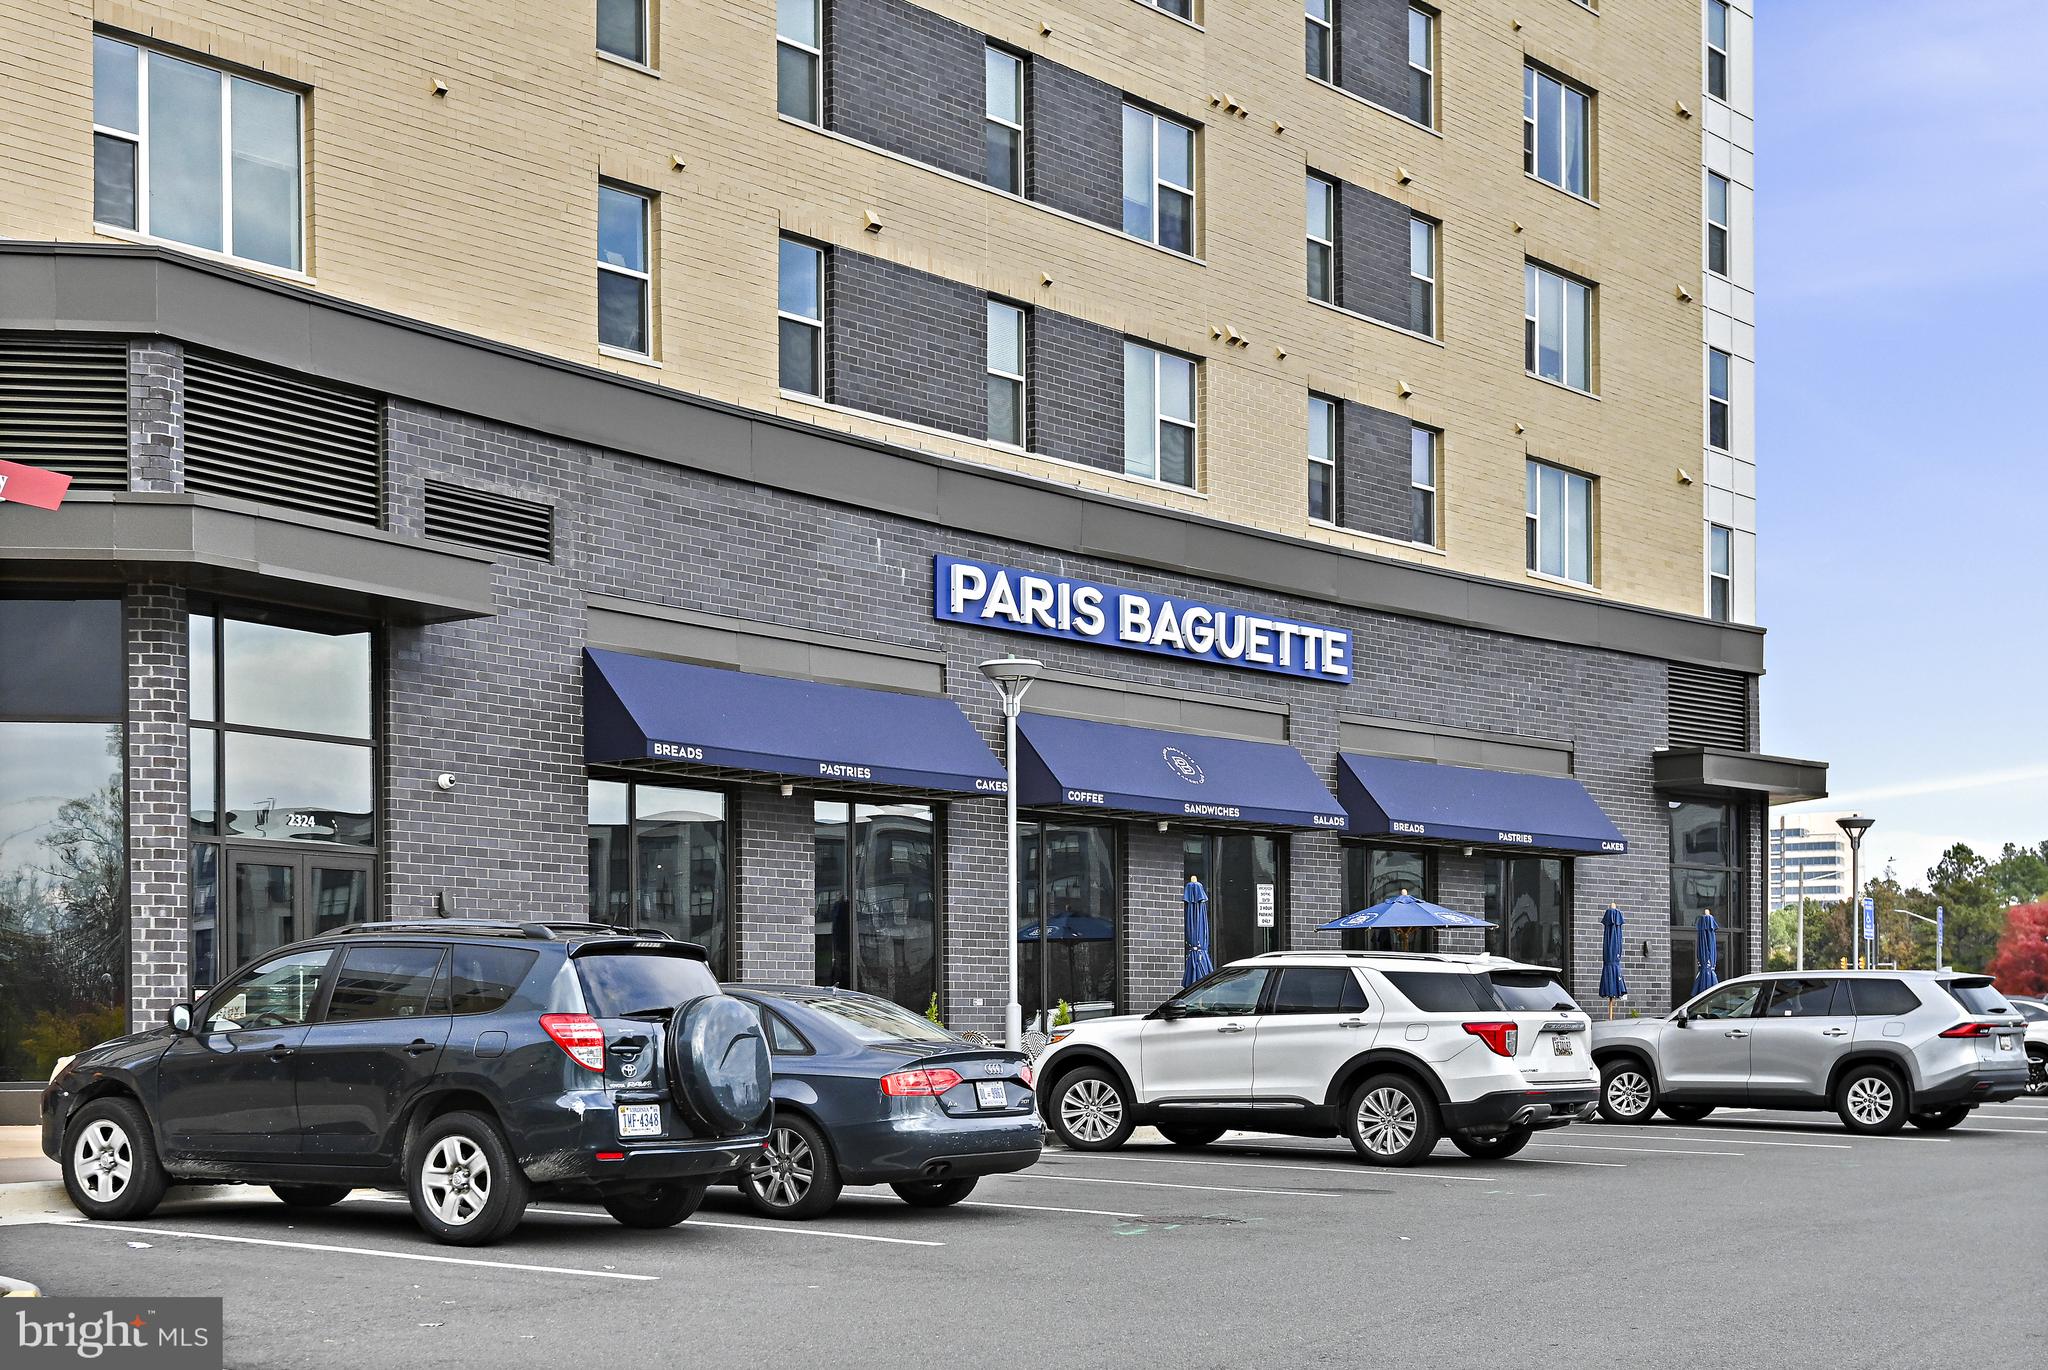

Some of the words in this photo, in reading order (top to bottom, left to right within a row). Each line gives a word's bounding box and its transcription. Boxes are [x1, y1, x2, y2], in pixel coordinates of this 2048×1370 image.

[950, 563, 1106, 636] PARIS
[1119, 593, 1348, 675] BAGUETTE
[653, 743, 704, 760] BREADS
[819, 763, 871, 779] PASTRIES
[975, 779, 1008, 792] CAKES
[1067, 791, 1104, 804] COFFEE
[1184, 803, 1240, 817] SANDWICHES
[288, 813, 315, 827] 2324
[1313, 815, 1345, 826] SALADS
[1393, 822, 1425, 834] BREADS
[1498, 832, 1533, 843] PASTRIES
[1601, 842, 1624, 852] CAKES
